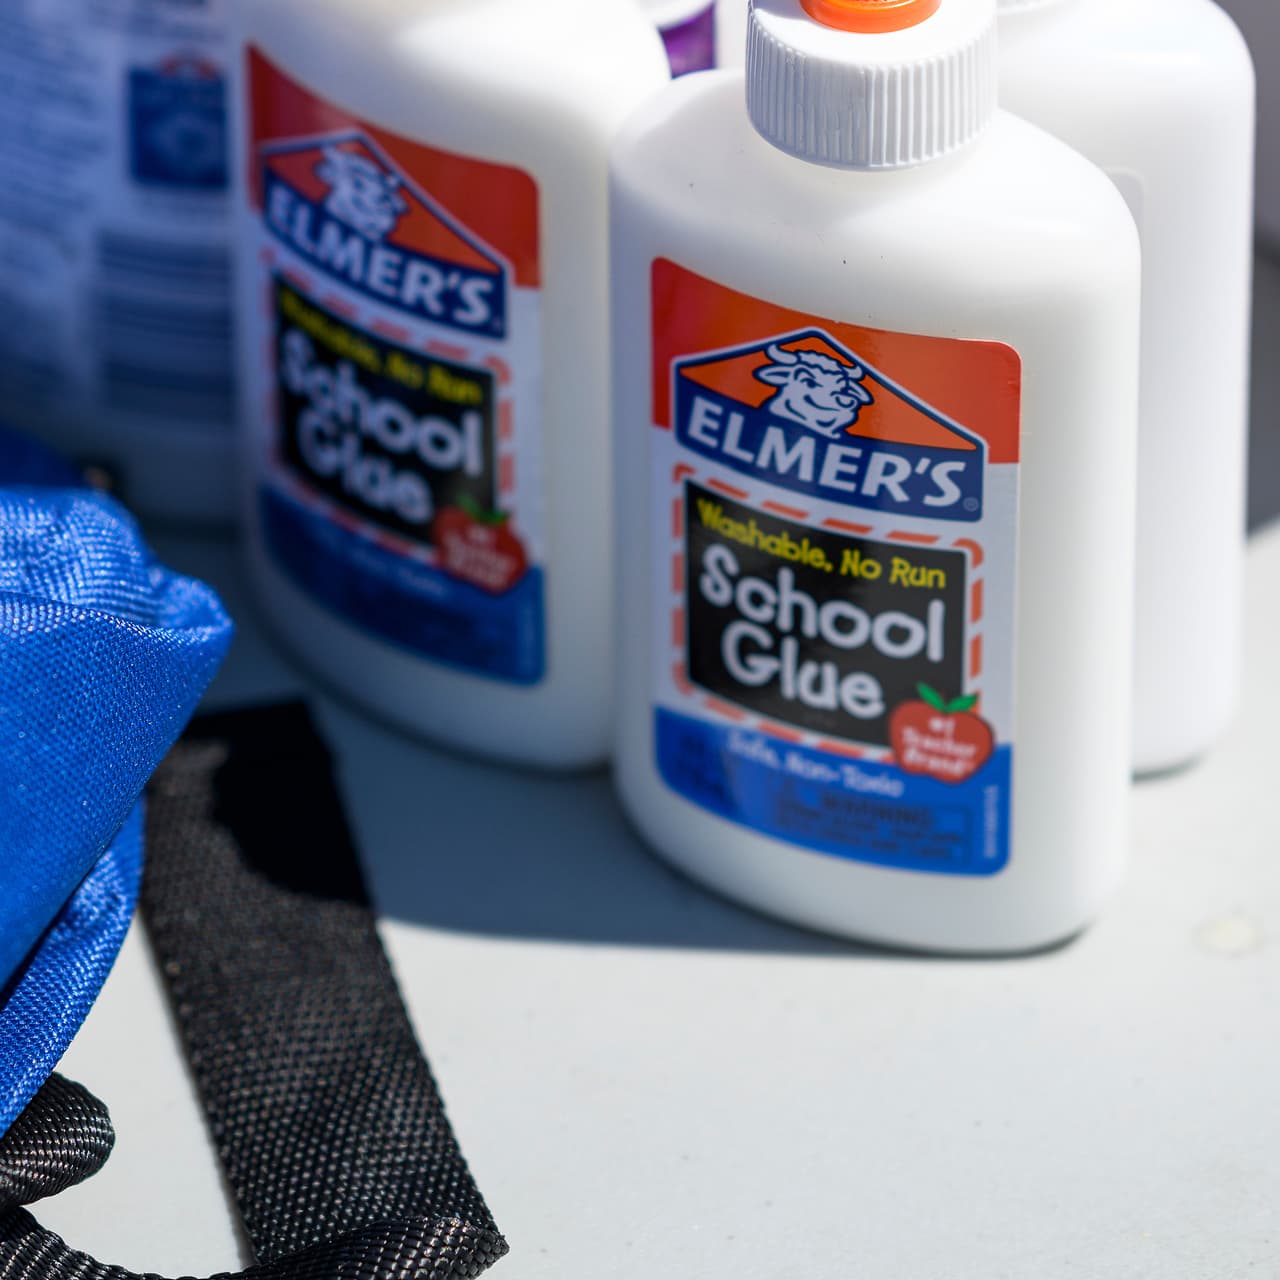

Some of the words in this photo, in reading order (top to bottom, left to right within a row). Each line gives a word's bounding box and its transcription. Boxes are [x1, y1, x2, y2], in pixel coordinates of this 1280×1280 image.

[271, 183, 494, 325] ELMER'S
[283, 329, 484, 476] School
[687, 396, 966, 508] ELMER'S
[297, 406, 434, 524] Glue
[697, 498, 833, 572] Washable,
[840, 549, 881, 581] No
[889, 557, 947, 589] Run
[699, 543, 946, 662] School
[721, 621, 885, 719] Glue
